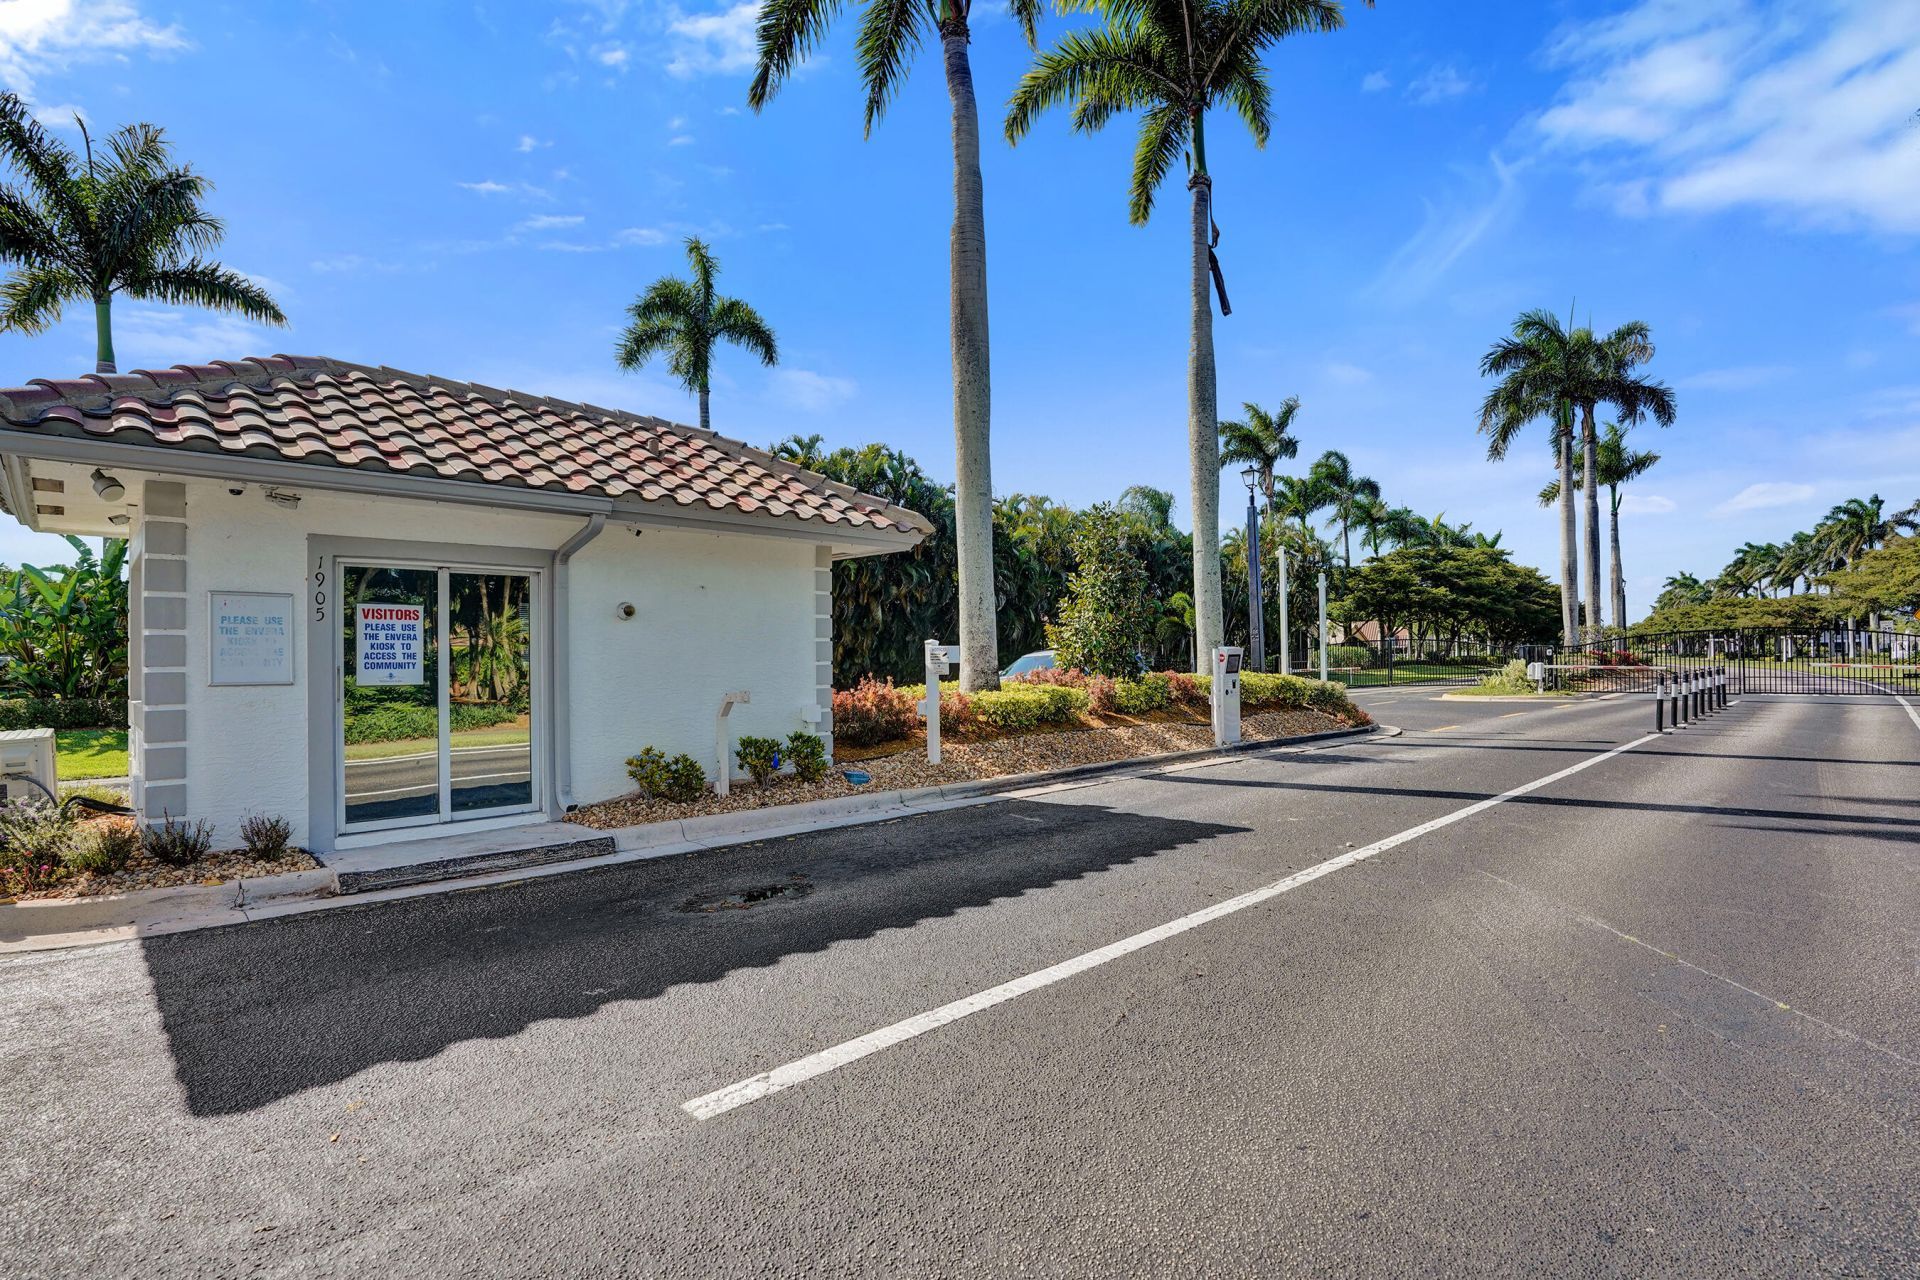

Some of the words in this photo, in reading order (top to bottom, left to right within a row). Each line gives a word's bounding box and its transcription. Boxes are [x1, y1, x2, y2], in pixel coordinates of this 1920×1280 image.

[315, 556, 325, 621] 1905
[362, 608, 419, 620] VISITORS
[220, 616, 258, 624] PLEASE
[264, 616, 284, 625] USE
[219, 627, 238, 635] THE
